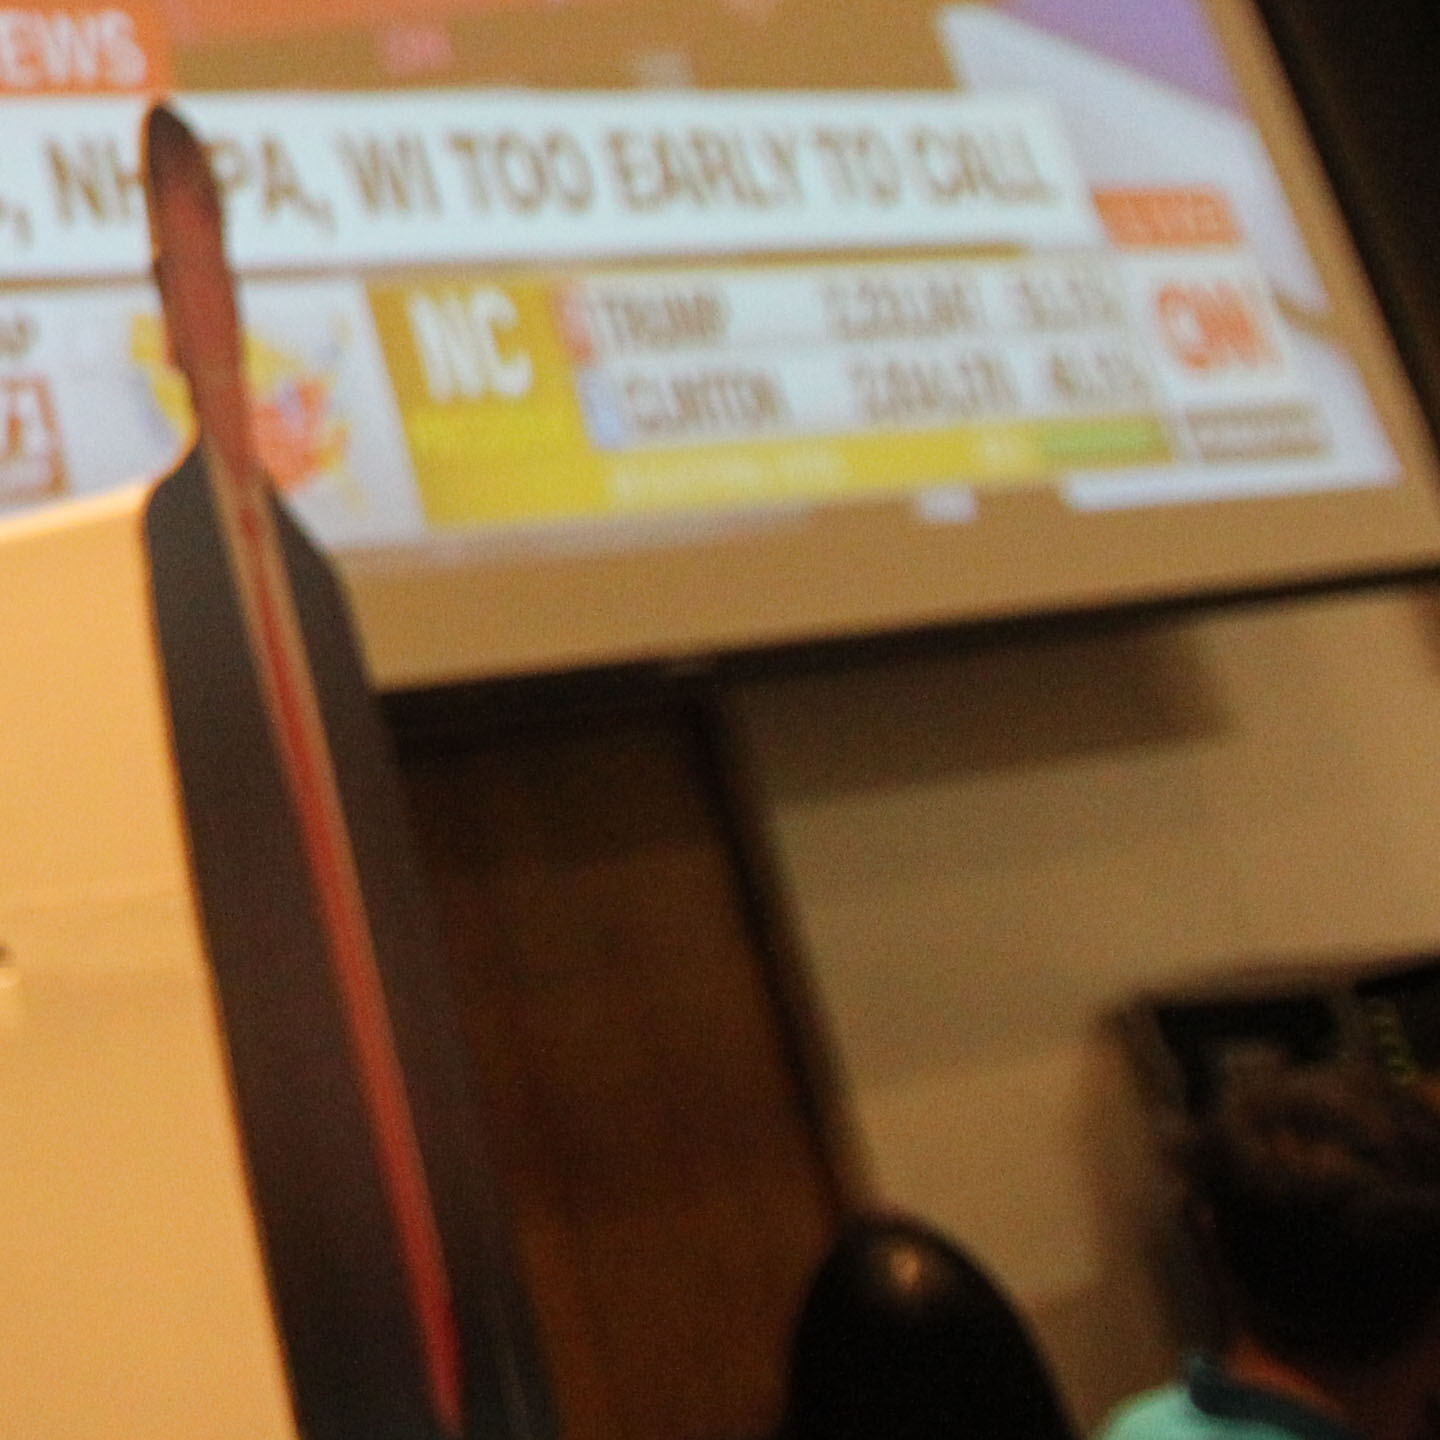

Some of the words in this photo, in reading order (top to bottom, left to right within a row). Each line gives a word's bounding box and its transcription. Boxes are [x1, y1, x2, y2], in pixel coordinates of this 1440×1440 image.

[204, 128, 338, 244] PA,
[337, 125, 444, 217] WI
[445, 123, 596, 216] TOO
[604, 122, 804, 212] EARLY
[806, 122, 901, 208] TO
[904, 120, 1060, 209] CALL
[407, 284, 534, 404] NC
